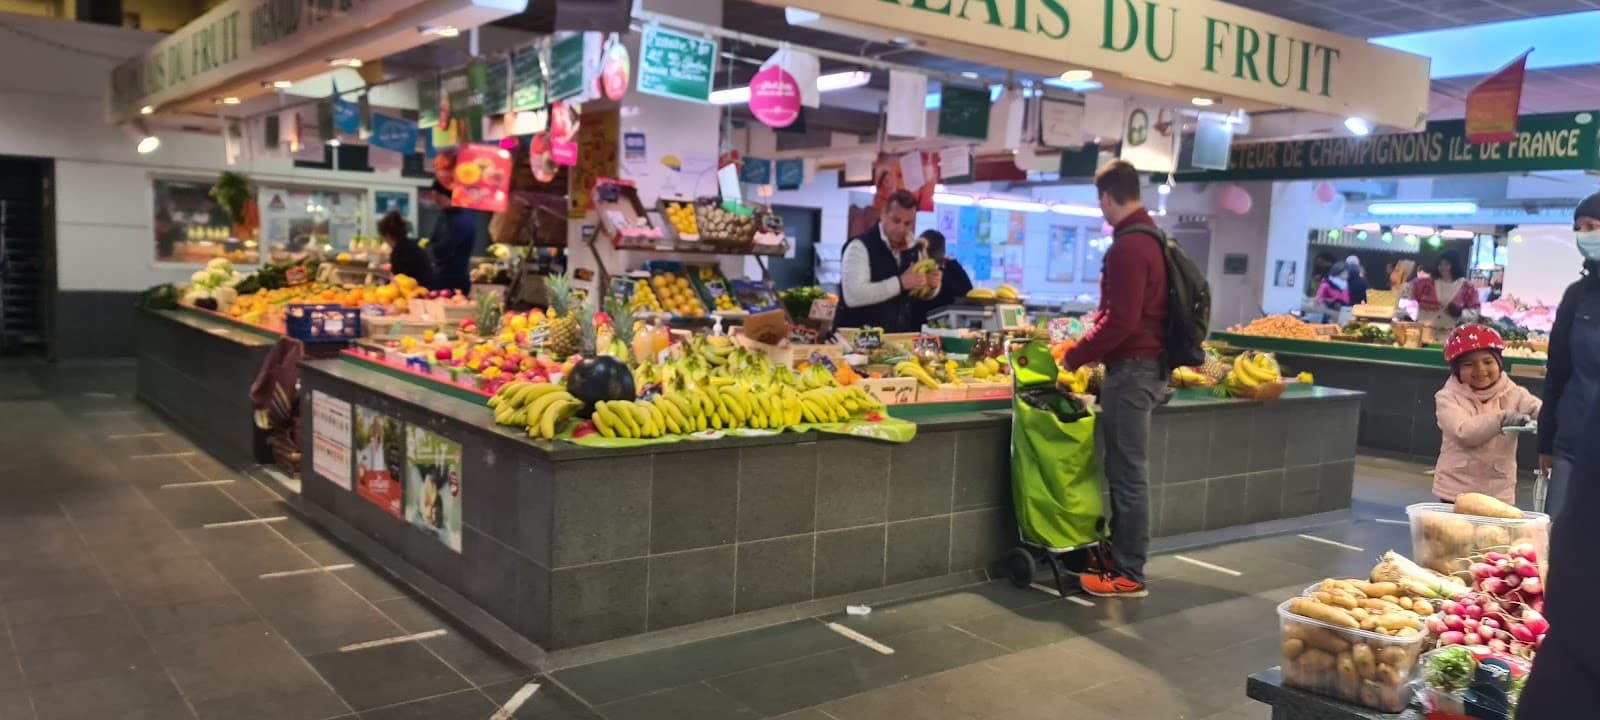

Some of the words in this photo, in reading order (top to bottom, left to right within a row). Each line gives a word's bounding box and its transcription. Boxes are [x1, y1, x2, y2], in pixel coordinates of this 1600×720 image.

[192, 10, 240, 76] FRUIT
[1098, 0, 1179, 62] DU
[1201, 16, 1341, 97] FRUIT
[1282, 141, 1304, 168] DE
[1310, 130, 1444, 167] CHAMPIGNONS
[1449, 136, 1472, 161] ILE
[1508, 128, 1580, 159] FRANCE
